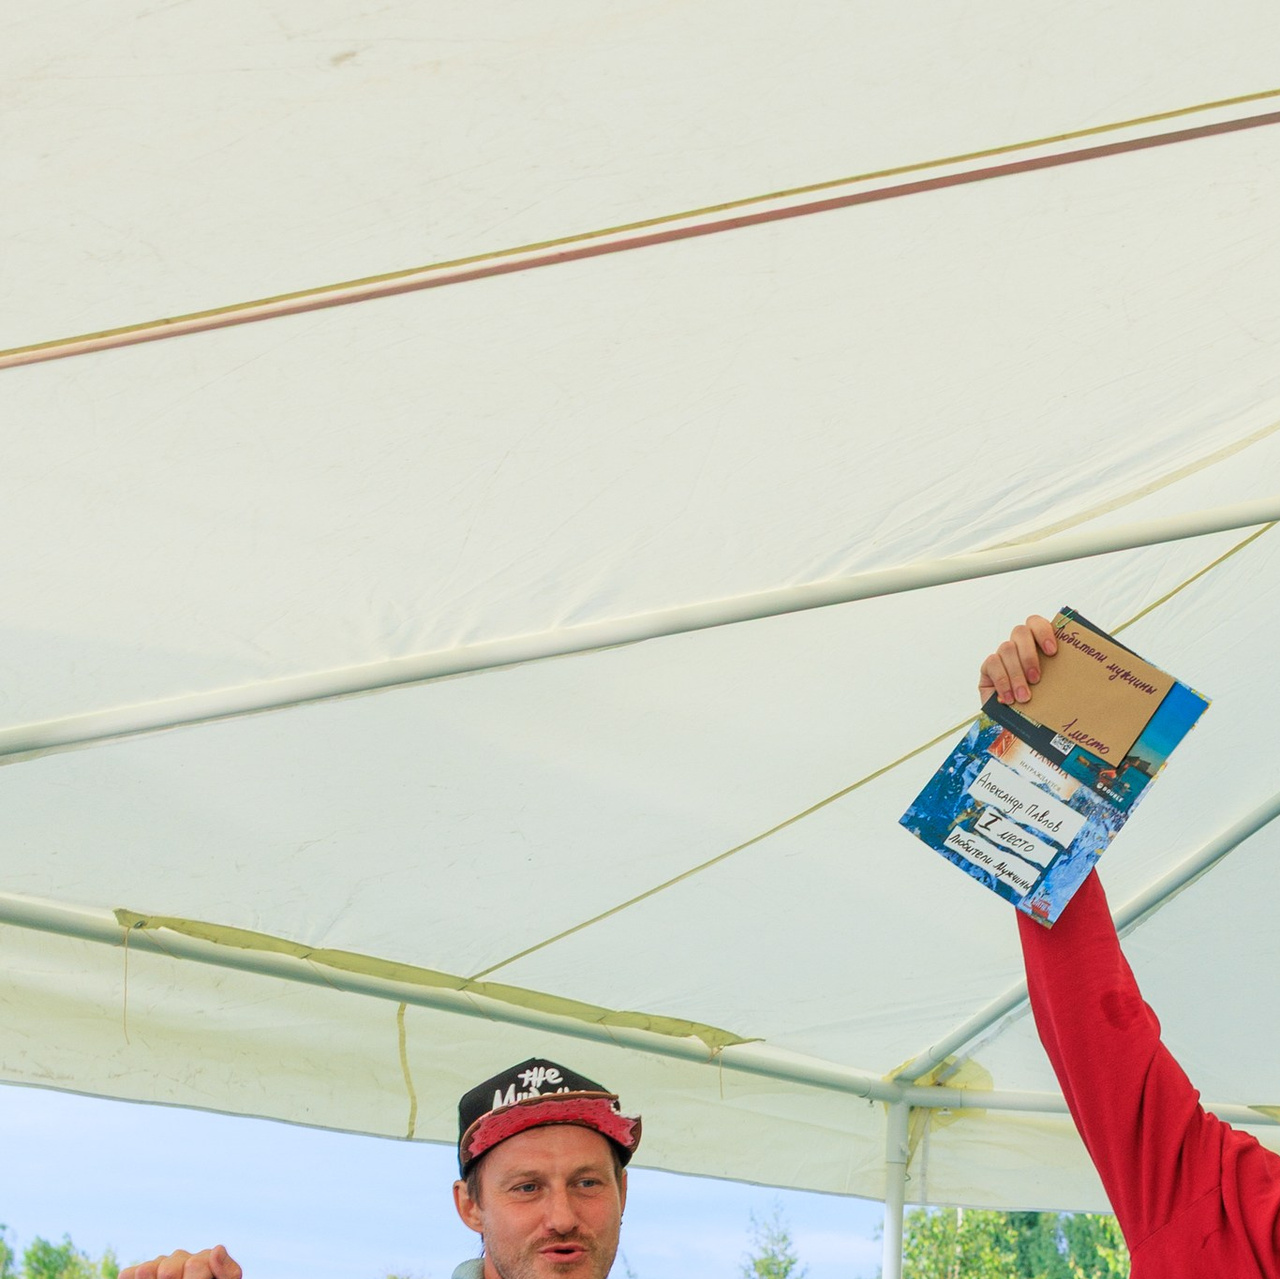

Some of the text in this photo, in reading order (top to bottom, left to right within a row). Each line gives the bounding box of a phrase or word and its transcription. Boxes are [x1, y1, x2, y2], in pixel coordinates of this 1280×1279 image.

[1053, 626, 1158, 695] Любители мужчины
[1062, 718, 1078, 732] 1
[1068, 731, 1110, 754] место
[977, 772, 1063, 833] Александр Павлов
[949, 834, 993, 864] Любители
